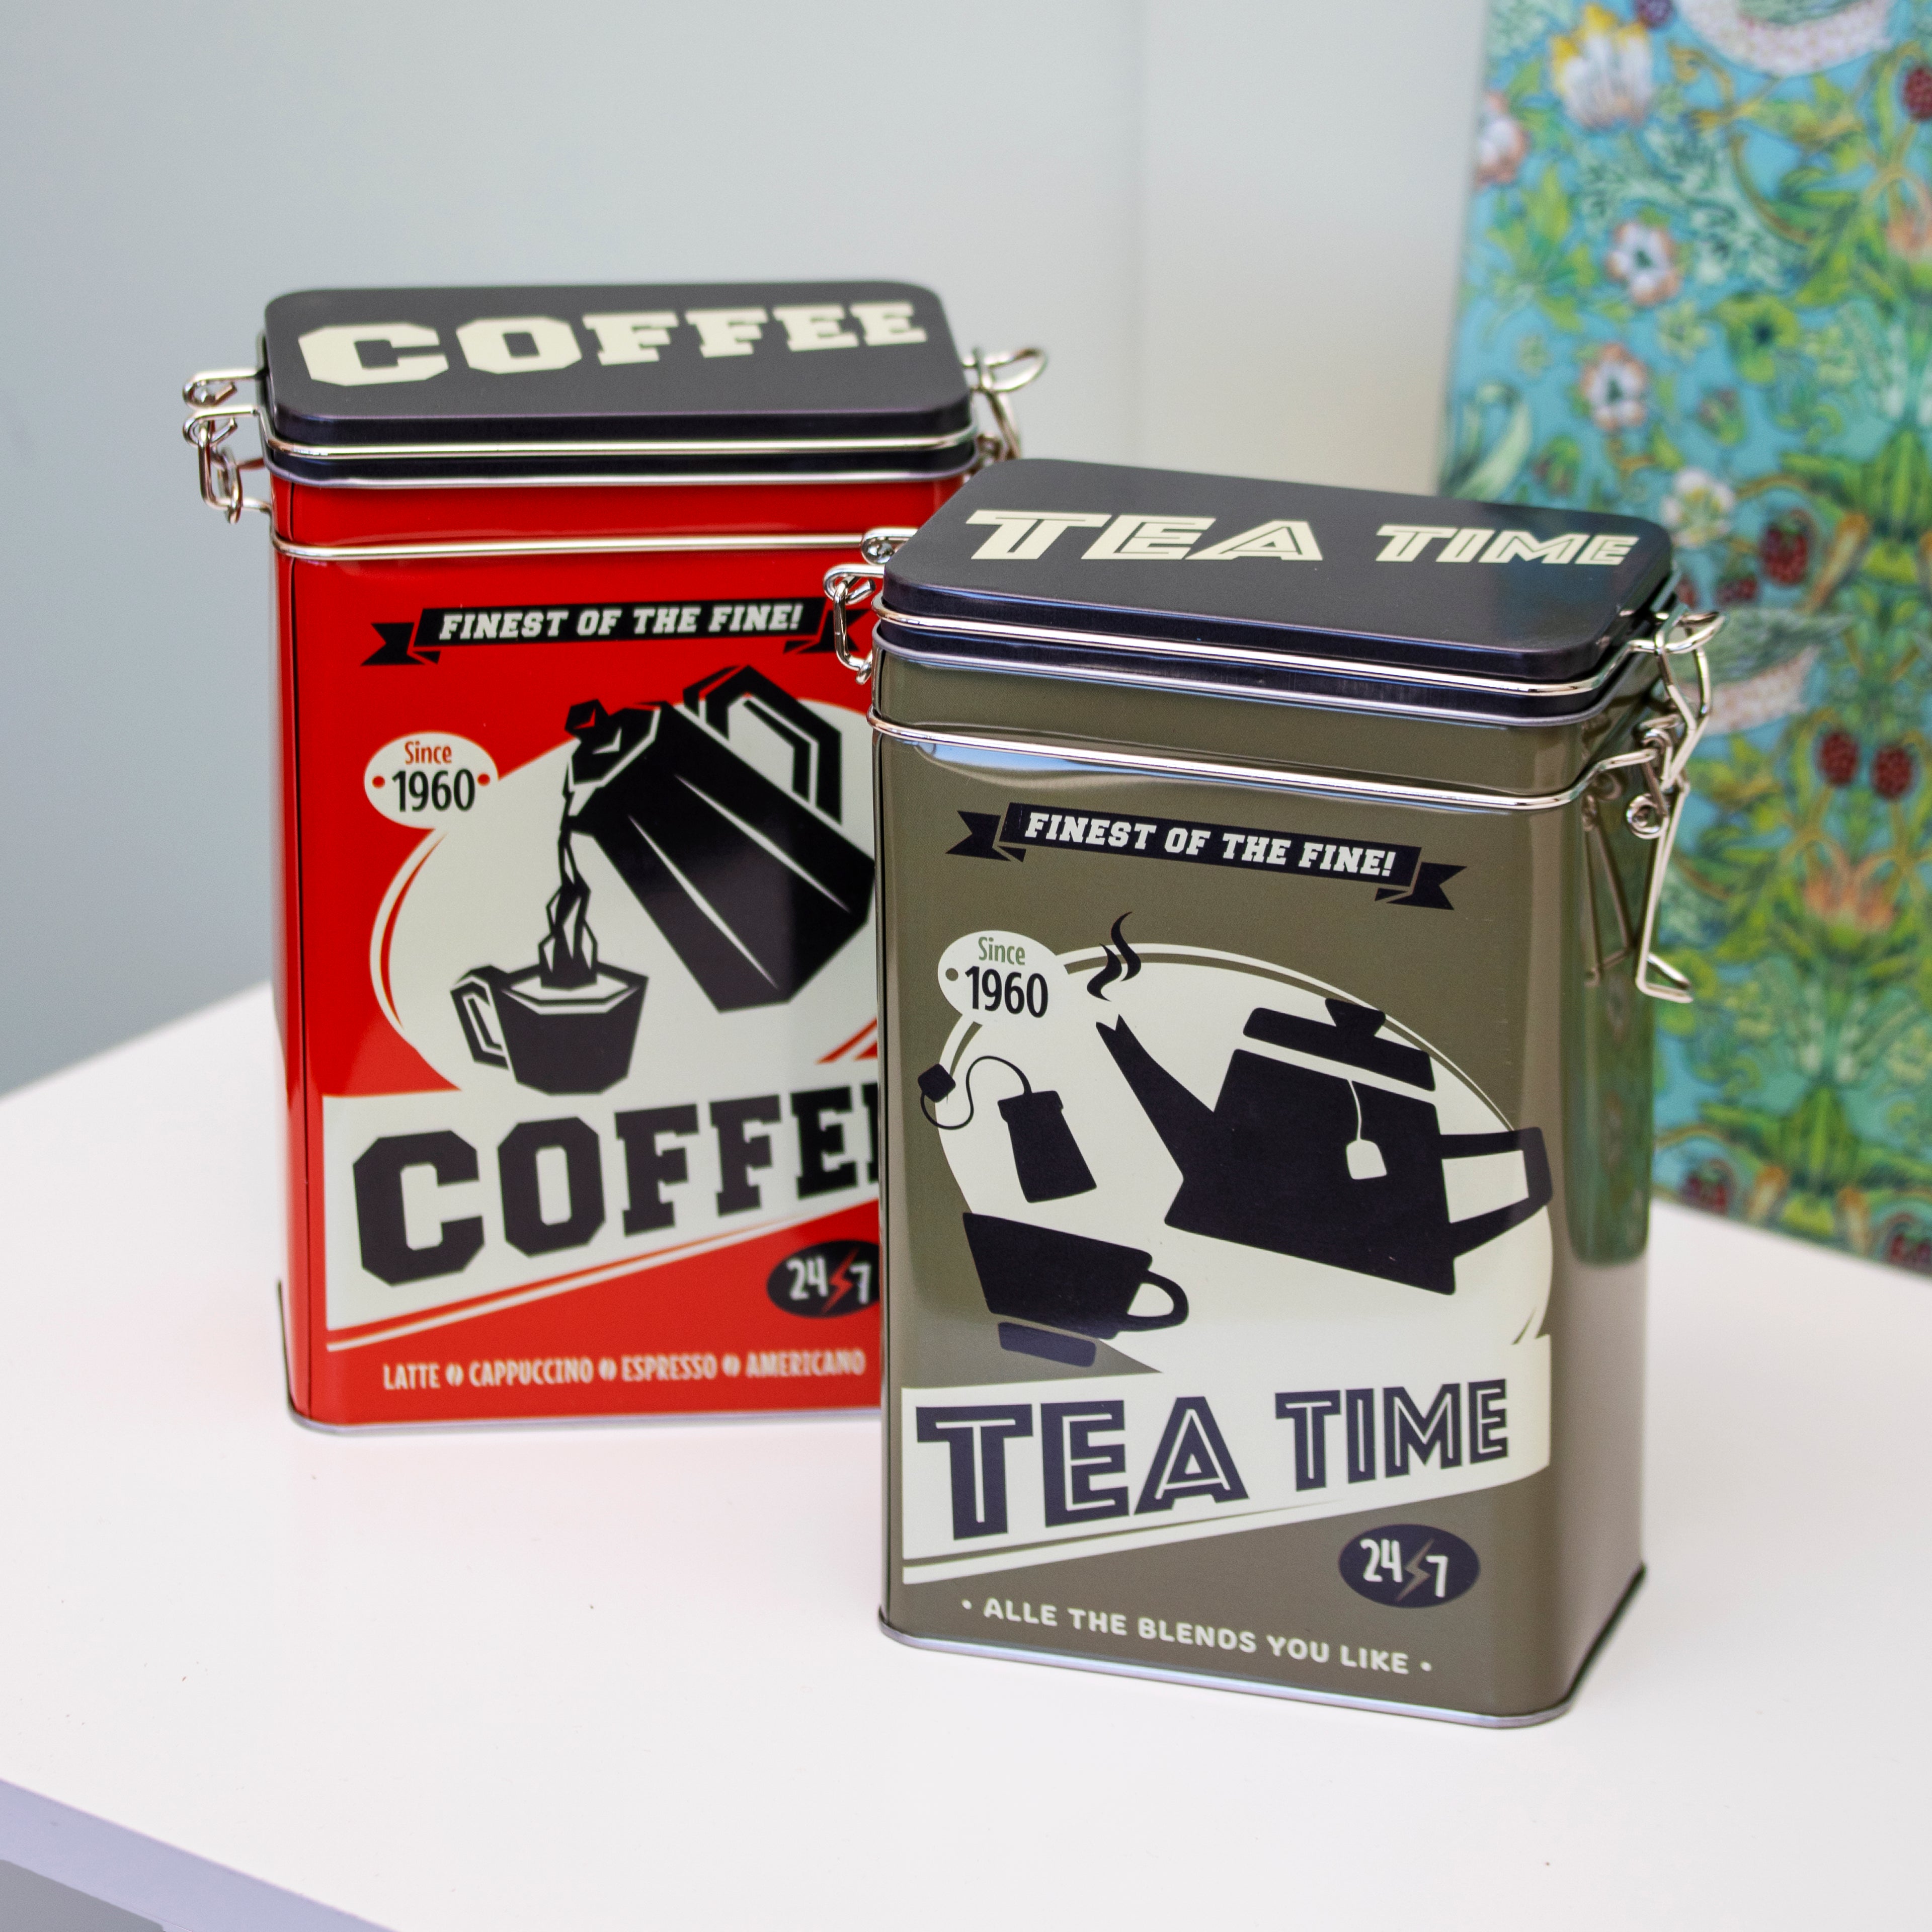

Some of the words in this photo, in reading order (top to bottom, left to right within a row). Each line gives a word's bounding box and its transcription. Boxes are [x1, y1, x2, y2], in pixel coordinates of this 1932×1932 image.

[298, 303, 927, 386] COFFEE
[966, 510, 1323, 560] TEA
[1376, 525, 1639, 565] TIME
[439, 611, 568, 639] FINEST
[577, 609, 622, 636] OF
[633, 607, 702, 634] THE
[709, 604, 802, 632] FINE!
[405, 741, 452, 764] Since
[392, 768, 475, 812] 1960
[1025, 813, 1156, 850] FINEST
[1165, 827, 1211, 855] OF
[1222, 833, 1292, 866] THE
[1299, 843, 1396, 877] FINE!
[978, 936, 1025, 965] Since
[965, 965, 1049, 1018] 1960
[352, 1083, 878, 1287] COFFE
[383, 1363, 440, 1390] LATTE
[469, 1357, 593, 1387] CAPPUCCINO
[622, 1353, 717, 1381] ESPRESSO
[746, 1348, 866, 1378] AMERICANO
[916, 1396, 1249, 1541] TEA
[1275, 1379, 1508, 1493] TIME
[984, 1597, 1058, 1626] ALLE
[1068, 1609, 1127, 1636] THE
[1139, 1618, 1257, 1653] BLENDS
[1267, 1635, 1331, 1664] YOU
[1341, 1644, 1409, 1675] LIKE
